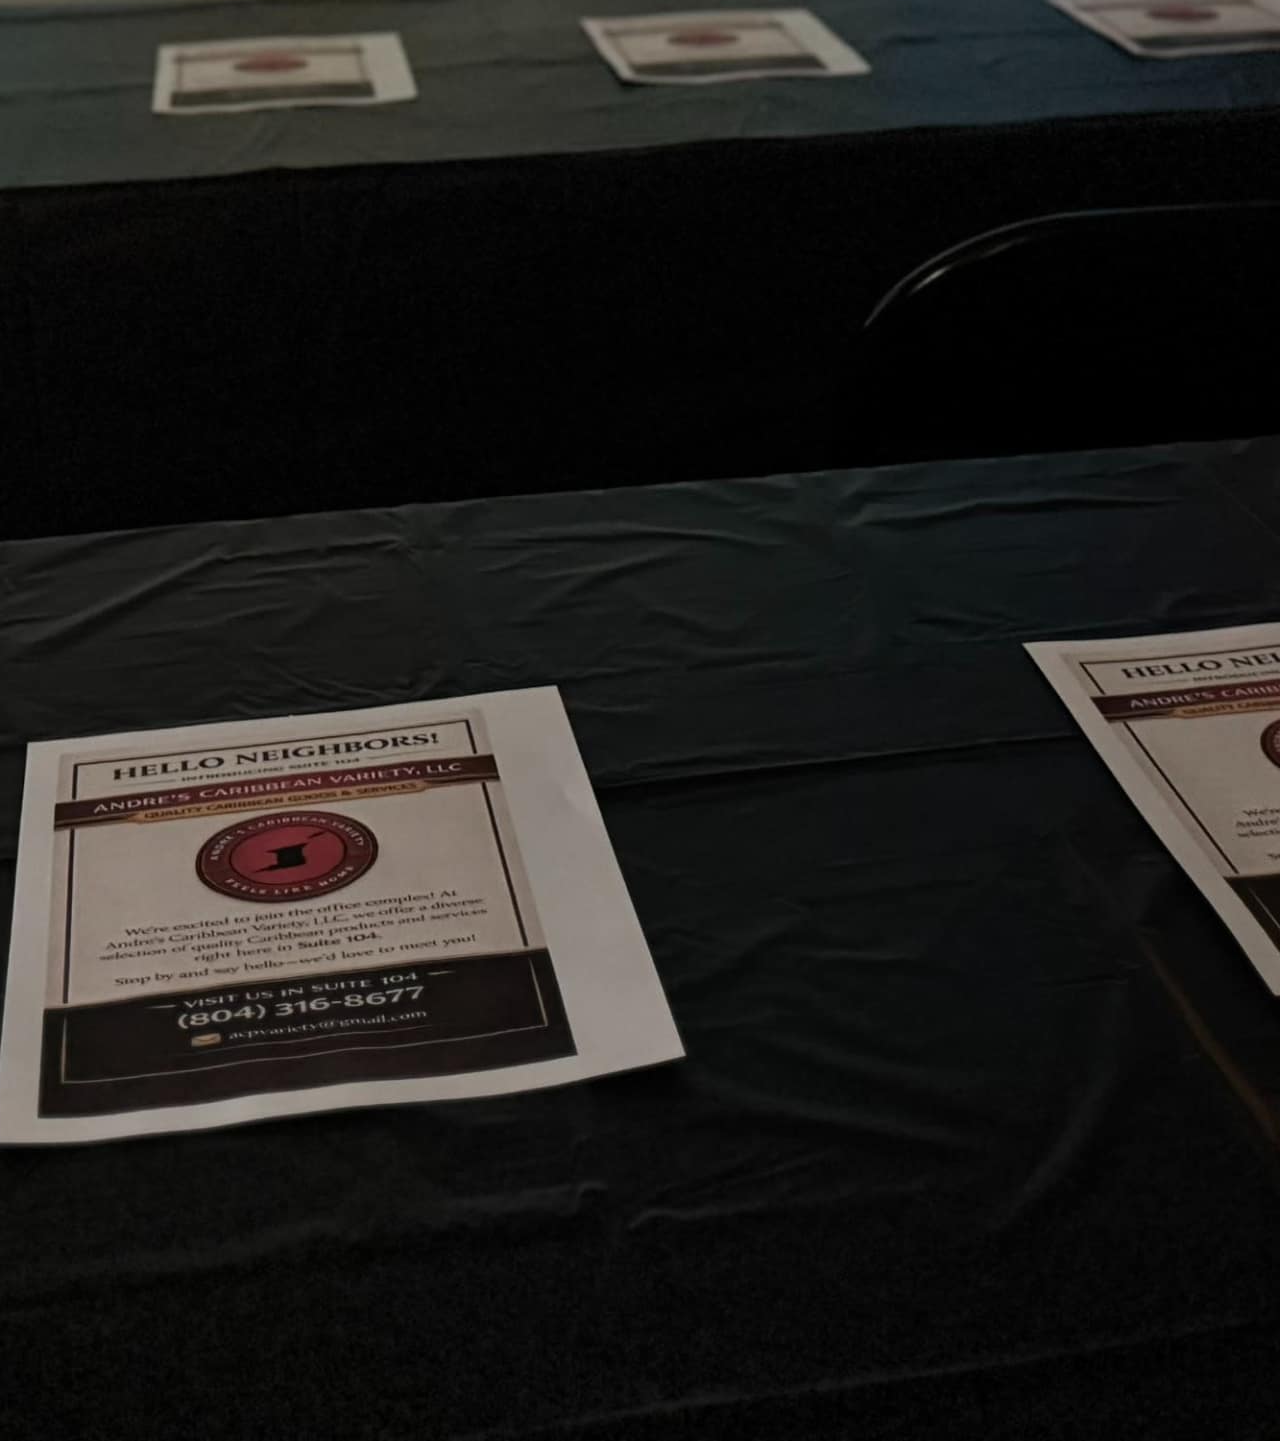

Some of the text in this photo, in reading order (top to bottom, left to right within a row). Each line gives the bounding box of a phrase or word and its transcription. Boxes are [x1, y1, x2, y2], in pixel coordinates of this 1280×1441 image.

[1121, 660, 1223, 678] HELLO
[1130, 691, 1215, 708] ANDRE'S
[113, 732, 439, 780] HELLO NEIGHBORS!
[181, 766, 283, 782] INTRODUCING
[288, 761, 328, 769] SUITE
[94, 762, 461, 814] ANDRE'S CARIBBEAN VARIETY, LLC
[144, 806, 201, 819] QUALITY
[206, 797, 283, 811] CARIBBEAN
[287, 791, 336, 801] GOODS
[356, 782, 416, 794] SERVICES
[225, 865, 356, 899] FEELS LIKE HOME
[105, 936, 165, 950] Andre's
[168, 928, 247, 942] Caribbean
[250, 920, 309, 932] Variety,
[352, 911, 375, 919] we
[378, 905, 414, 916] offer
[430, 898, 484, 909] diverse
[125, 926, 168, 936] We're
[172, 916, 228, 930] excited
[254, 912, 283, 922] join
[288, 908, 313, 916] the
[316, 902, 361, 913] office
[364, 891, 434, 907] complex!
[440, 890, 456, 898] At
[99, 908, 488, 961] selection of quality Caribbean products and services
[194, 932, 382, 962] right here in Suite 104.
[114, 976, 151, 986] Stop
[154, 972, 172, 982] by
[178, 968, 208, 979] and
[213, 966, 240, 974] say
[341, 950, 374, 959] love
[399, 939, 436, 951] meet
[442, 934, 476, 947] you!
[178, 985, 424, 1029] (804) 316-8677
[184, 972, 417, 1008] VISIT US IN SUITE 104
